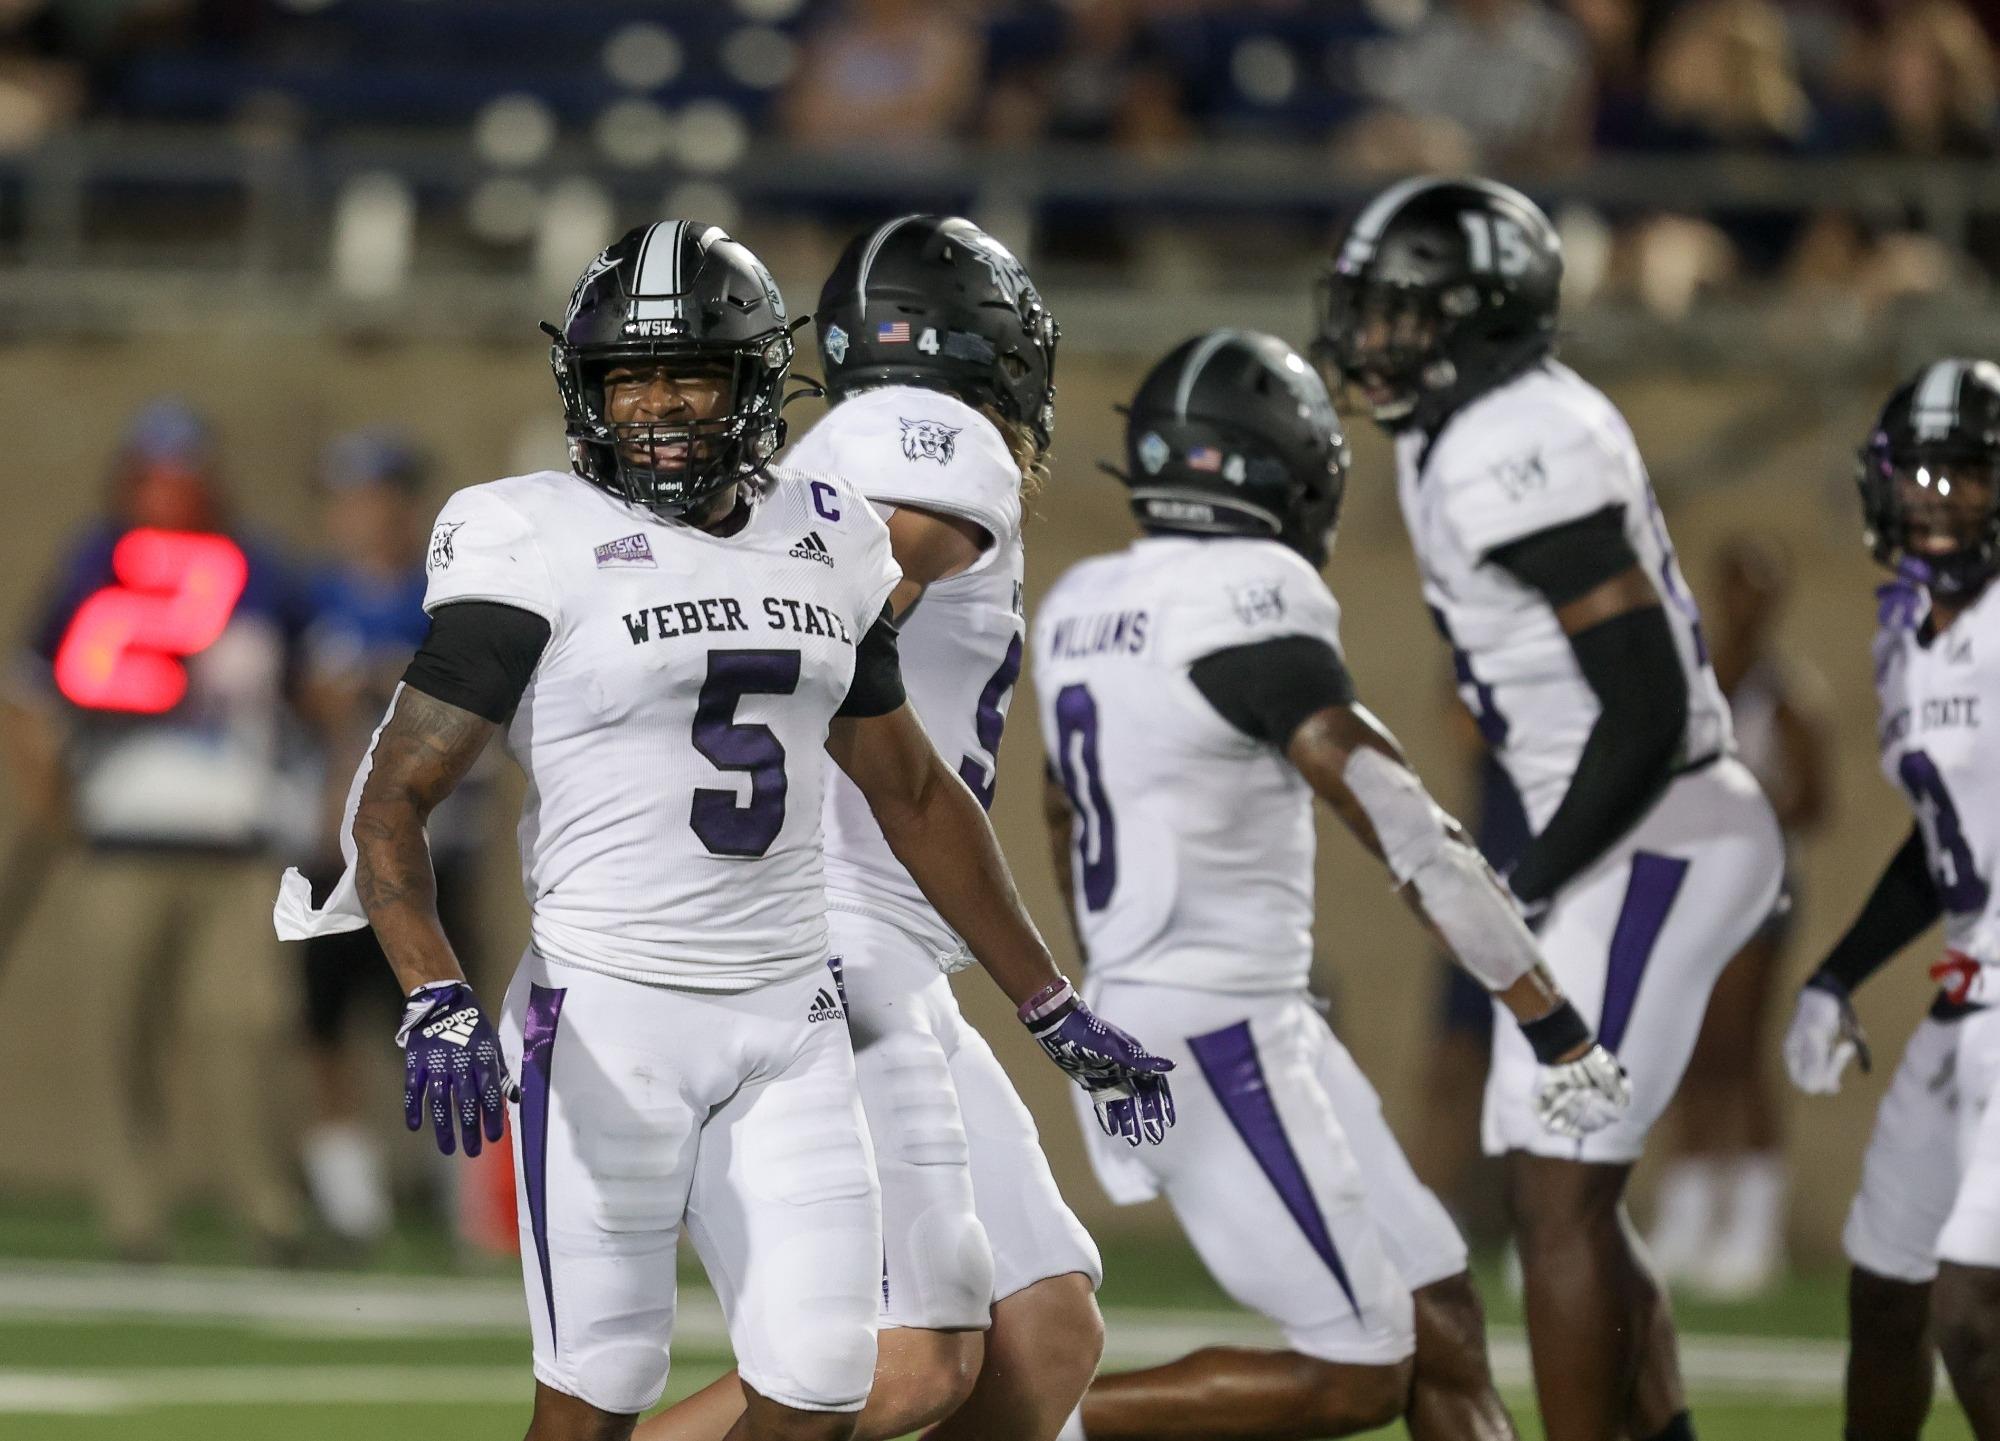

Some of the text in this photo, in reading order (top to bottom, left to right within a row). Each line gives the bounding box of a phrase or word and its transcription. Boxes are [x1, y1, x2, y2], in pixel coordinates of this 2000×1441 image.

[1461, 213, 1531, 276] 15
[638, 320, 672, 337] WSU
[917, 327, 941, 356] 4
[810, 480, 841, 523] C
[789, 547, 835, 569] adidas
[55, 526, 249, 714] 2
[622, 598, 749, 646] WEBER
[689, 649, 802, 859] 5
[1055, 682, 1119, 912] 0
[422, 1007, 480, 1039] adidas
